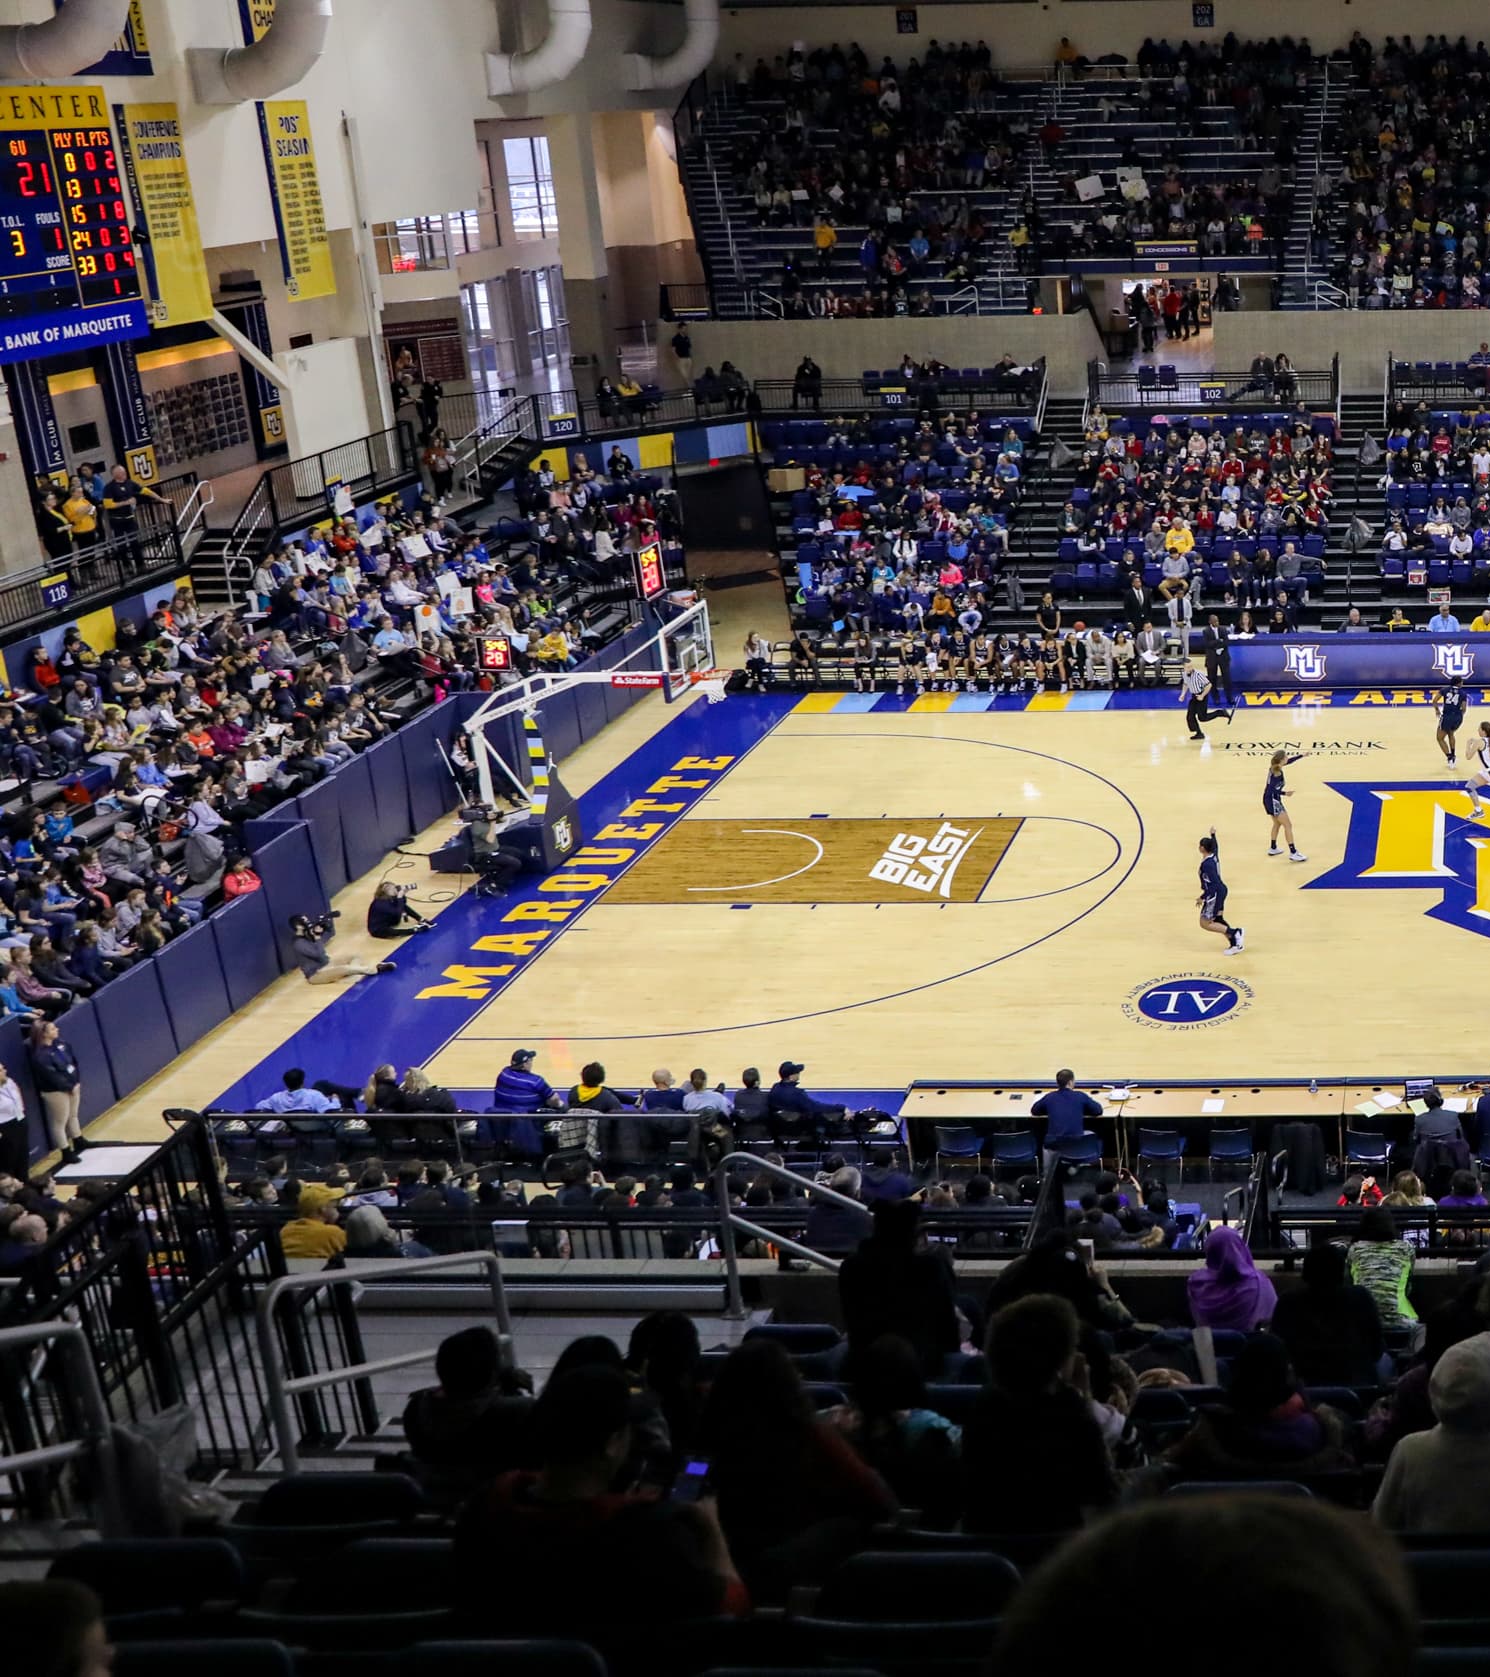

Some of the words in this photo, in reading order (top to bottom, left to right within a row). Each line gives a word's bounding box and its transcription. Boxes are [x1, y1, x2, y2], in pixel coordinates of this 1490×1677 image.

[902, 22, 914, 31] GA
[1197, 16, 1210, 25] GA
[0, 95, 104, 120] ENTER
[52, 131, 73, 148] PLY
[75, 131, 90, 147] FL
[89, 130, 110, 147] PTS
[63, 152, 77, 173] 0
[83, 151, 97, 172] 0
[103, 150, 116, 171] 2
[16, 161, 52, 197] 21
[66, 178, 82, 199] 13
[94, 178, 102, 195] 1
[108, 176, 121, 194] 4
[35, 211, 60, 225] FOULS
[71, 204, 88, 224] 15
[99, 203, 107, 220] 1
[113, 200, 126, 220] 8
[10, 230, 27, 257] 3
[54, 227, 64, 250] 1
[71, 230, 93, 251] 24
[99, 227, 112, 248] 0
[118, 224, 132, 245] 3
[46, 254, 71, 269] SCORE
[77, 255, 98, 277] 33
[104, 252, 117, 272] 0
[123, 251, 136, 268] 4
[1, 280, 9, 294] 3
[112, 278, 122, 295] 1
[4, 330, 42, 351] BANK
[43, 327, 61, 343] OF
[62, 313, 133, 340] MARQUETTE
[884, 393, 903, 404] 101
[1204, 389, 1221, 399] 102
[135, 397, 146, 426] CLUB
[266, 411, 282, 437] MU
[47, 419, 58, 449] CLUB
[141, 427, 149, 438] M
[554, 420, 573, 433] 120
[54, 451, 63, 462] M
[131, 453, 153, 480] MU
[642, 565, 661, 594] 28
[48, 584, 69, 603] 118
[485, 652, 505, 666] 28
[1284, 644, 1328, 682] MU
[1431, 643, 1475, 680] MU
[1242, 690, 1333, 706] WE
[1445, 692, 1459, 705] 24
[1221, 741, 1301, 750] TOWN
[1312, 741, 1387, 750] BANK
[552, 815, 574, 853] MU
[868, 832, 928, 884] BIG
[901, 821, 970, 892] EAST
[415, 755, 735, 1000] MARQUETTE
[1127, 972, 1193, 999] UNIVERSITY
[1195, 972, 1255, 999] MARQUETTE
[1145, 990, 1233, 1015] AL
[1121, 1003, 1163, 1030] CENTER
